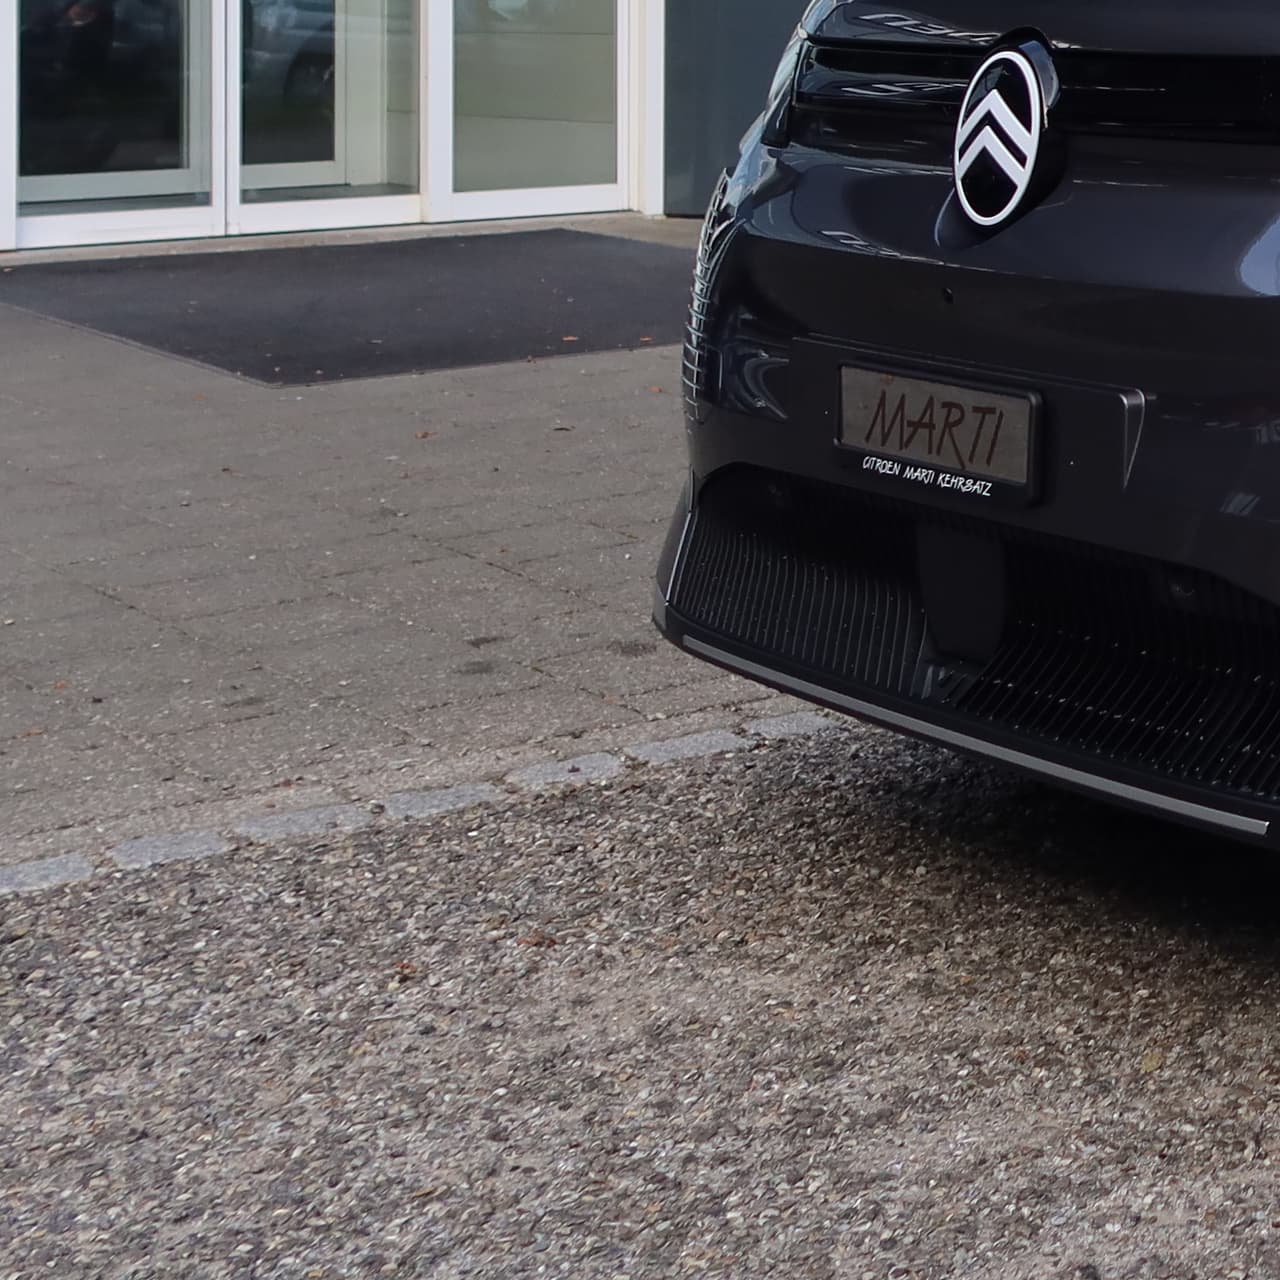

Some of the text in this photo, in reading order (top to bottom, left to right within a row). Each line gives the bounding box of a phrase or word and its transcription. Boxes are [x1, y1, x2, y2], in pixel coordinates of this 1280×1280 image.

[865, 389, 1004, 470] MARTI
[862, 455, 993, 497] CITROEN MARTI KEHRSATZ
